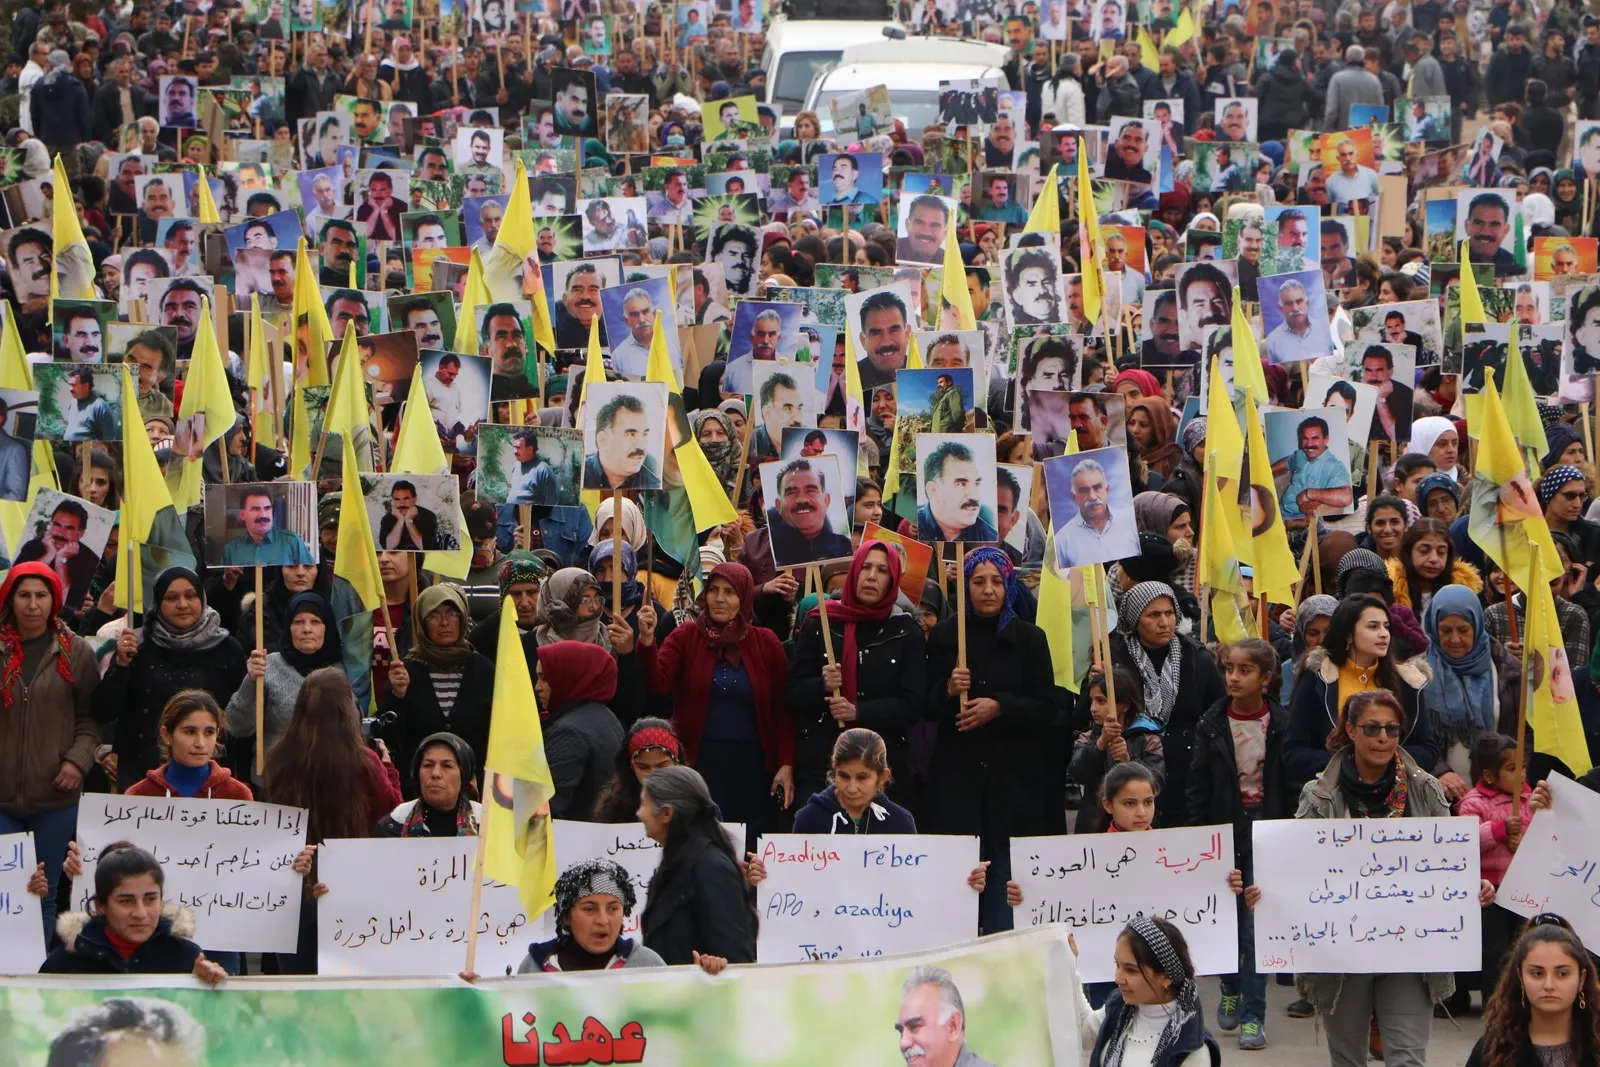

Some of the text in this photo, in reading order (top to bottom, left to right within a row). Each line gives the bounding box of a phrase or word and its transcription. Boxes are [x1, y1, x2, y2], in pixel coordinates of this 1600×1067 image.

[137, 805, 174, 829] العالم
[180, 810, 207, 827] قوة
[217, 804, 267, 826] امتلكنا
[278, 809, 301, 835] إذا
[1317, 823, 1472, 847] عندما نعشق الحياة
[762, 840, 841, 871] Azadiya
[1106, 847, 1137, 879] هي
[1155, 832, 1221, 874] الحرية
[1360, 852, 1408, 877] الوطن
[1414, 856, 1467, 873] نعشق
[246, 892, 287, 911] قوات
[1309, 878, 1359, 904] الوطن
[834, 893, 913, 927] azadiya
[1183, 893, 1216, 925] إلى
[334, 917, 377, 948] ثورة
[496, 913, 526, 946] هي
[1414, 915, 1464, 940] ليس
[502, 1011, 646, 1066] عهدنا
